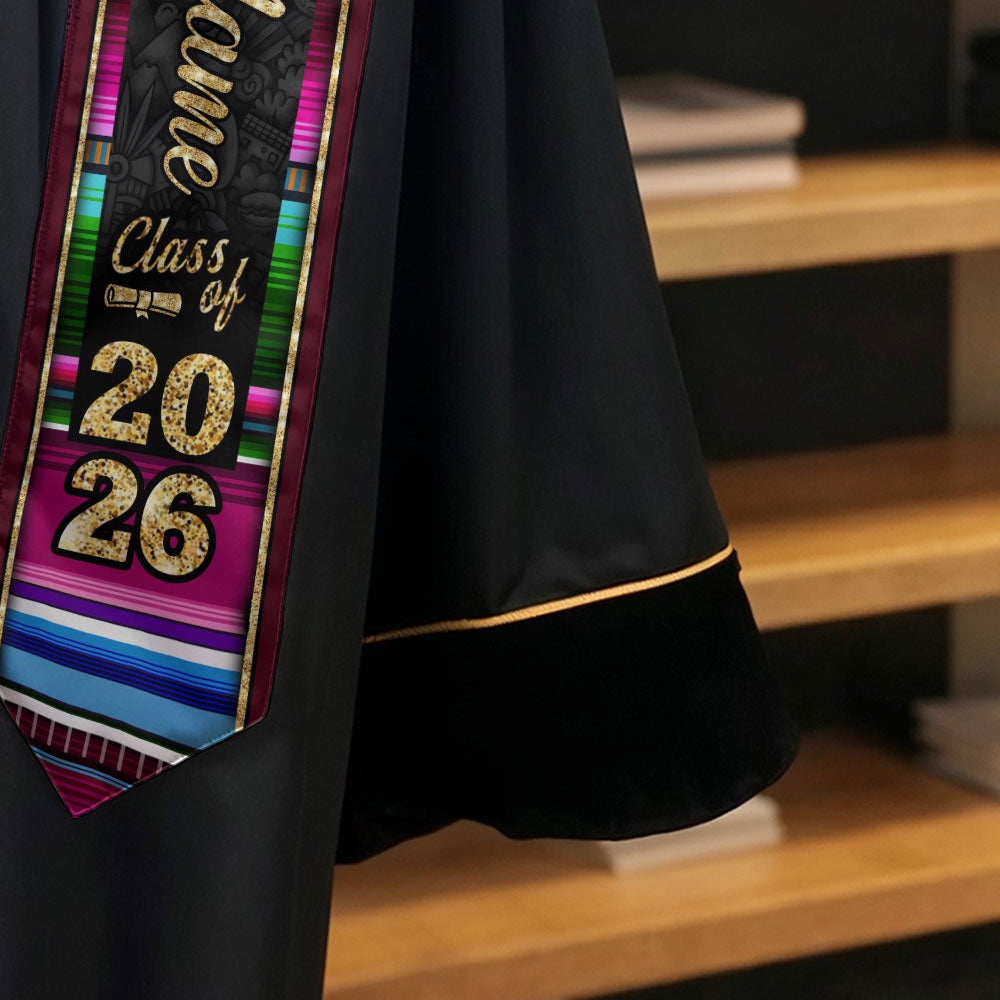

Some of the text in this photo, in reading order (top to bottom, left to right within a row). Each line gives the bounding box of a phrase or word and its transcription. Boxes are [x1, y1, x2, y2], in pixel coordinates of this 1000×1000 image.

[111, 216, 249, 332] Class of
[78, 340, 236, 456] 20
[57, 457, 217, 577] 26
